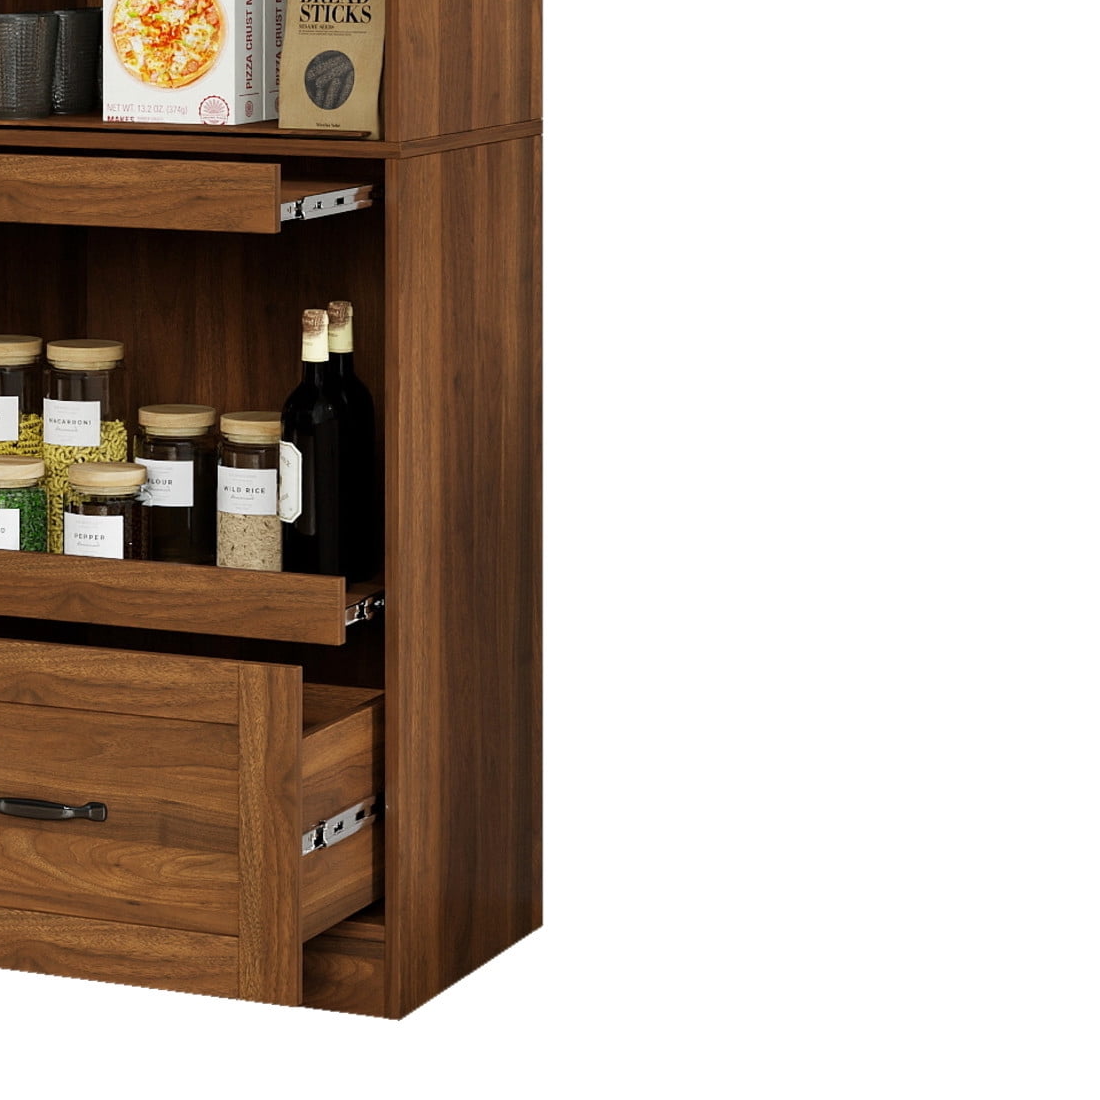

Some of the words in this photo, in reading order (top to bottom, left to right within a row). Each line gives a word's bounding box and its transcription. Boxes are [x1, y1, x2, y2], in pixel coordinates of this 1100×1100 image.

[275, 6, 283, 48] CRUST
[299, 4, 372, 23] STICKS
[245, 9, 253, 51] CRUST
[245, 53, 253, 90] PIZZA
[107, 103, 121, 112] NET
[166, 105, 188, 115] (374g)
[74, 533, 105, 541] PEPPER
